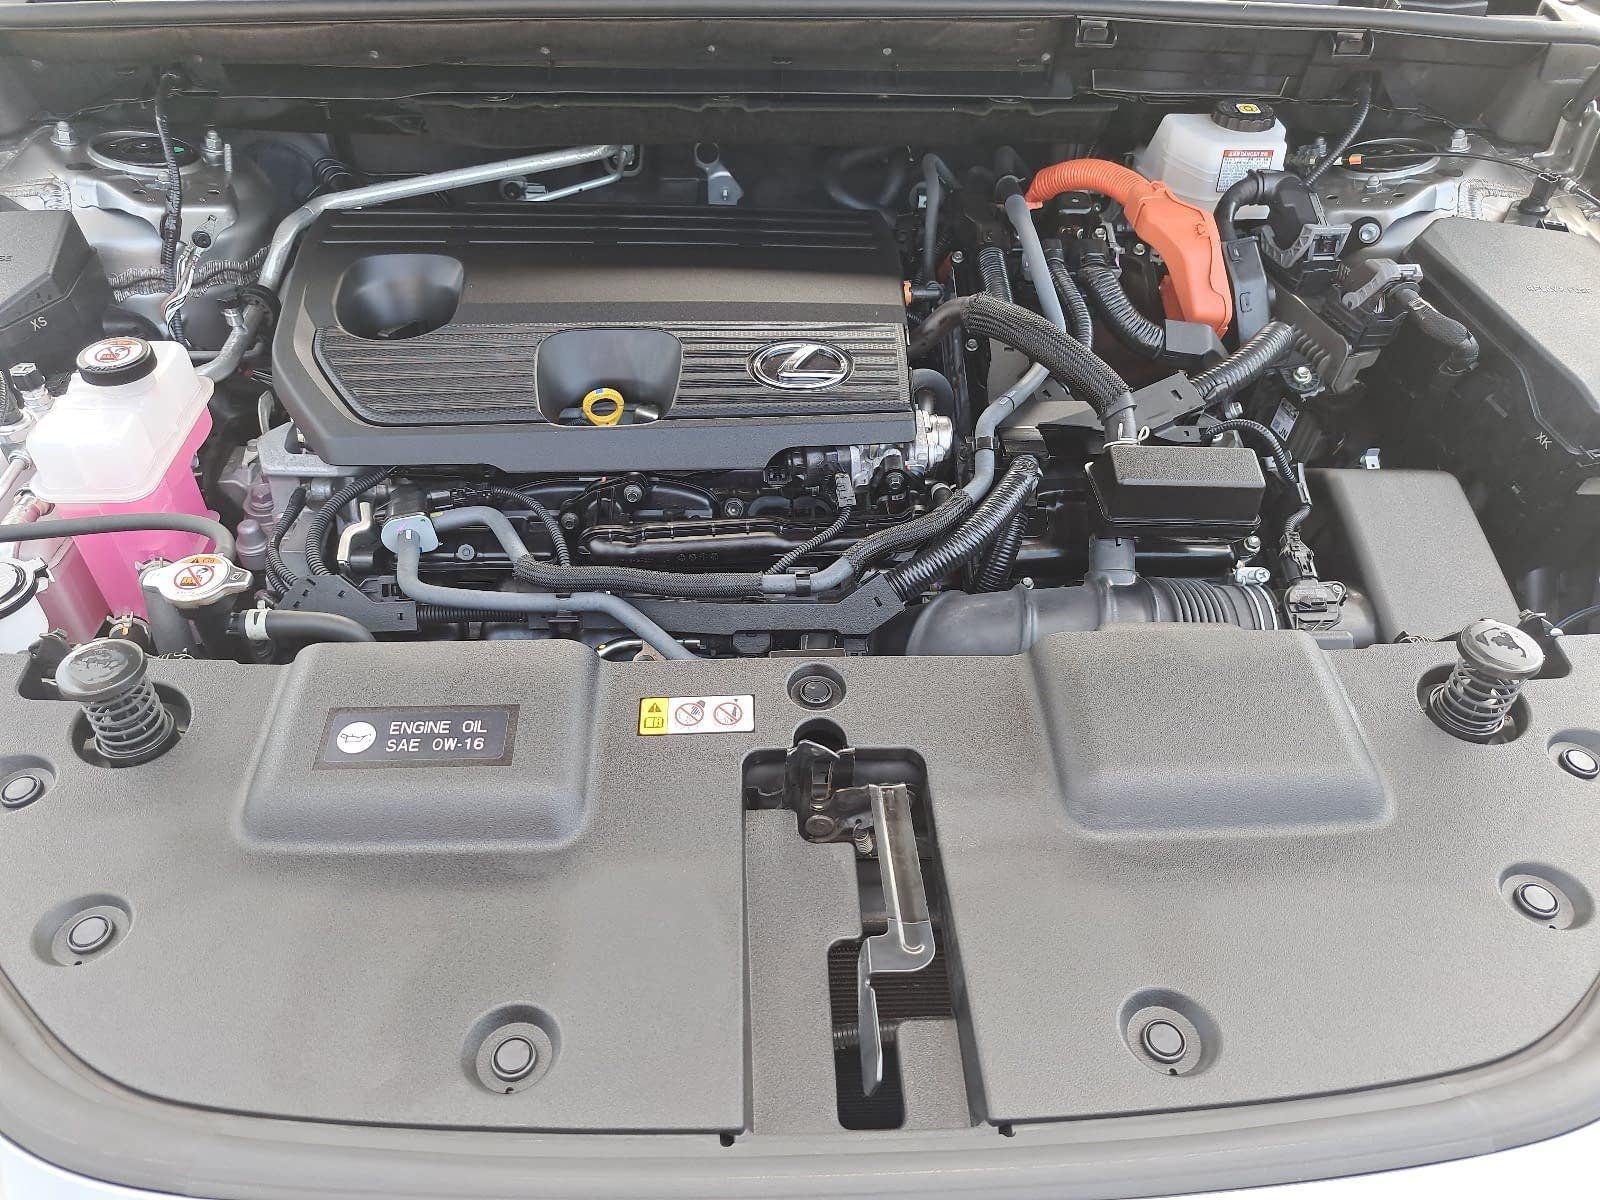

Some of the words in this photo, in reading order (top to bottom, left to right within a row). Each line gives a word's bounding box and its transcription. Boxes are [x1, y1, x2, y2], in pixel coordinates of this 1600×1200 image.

[30, 316, 48, 331] XS
[1534, 431, 1553, 450] XK
[389, 720, 452, 735] ENGINE
[462, 720, 487, 733] OIL
[386, 738, 421, 752] SAE
[432, 737, 485, 751] 0W-16
